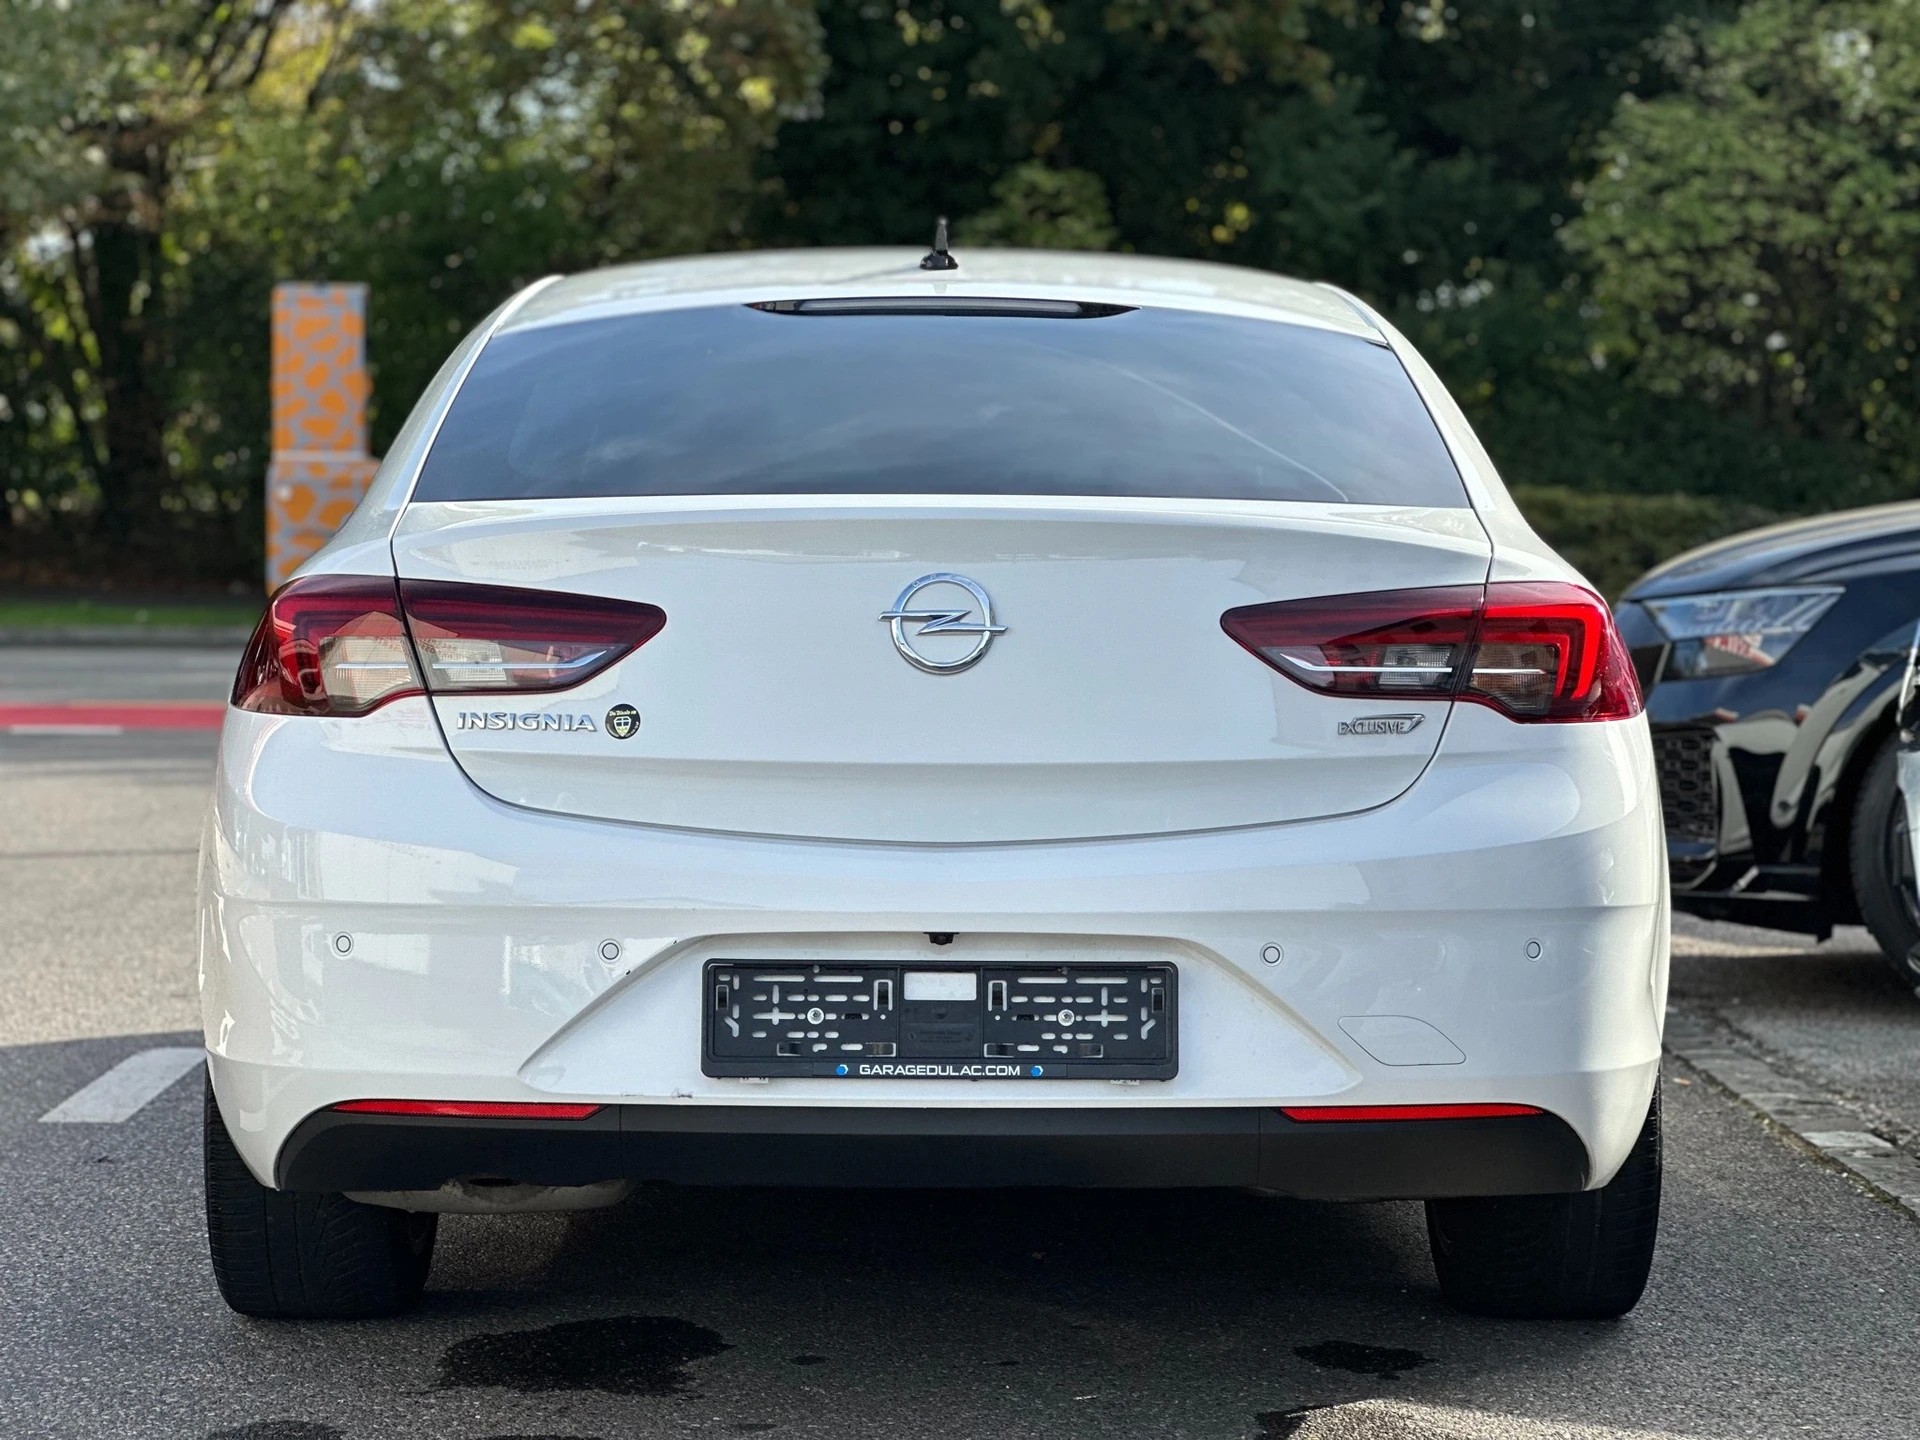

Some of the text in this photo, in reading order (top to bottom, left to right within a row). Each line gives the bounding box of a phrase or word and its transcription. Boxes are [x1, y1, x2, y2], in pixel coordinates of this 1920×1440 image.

[457, 712, 597, 732] INSIGNIA
[1338, 719, 1407, 735] EXCLUSIVE
[859, 1064, 1020, 1077] GARAGEDULAC.COM
